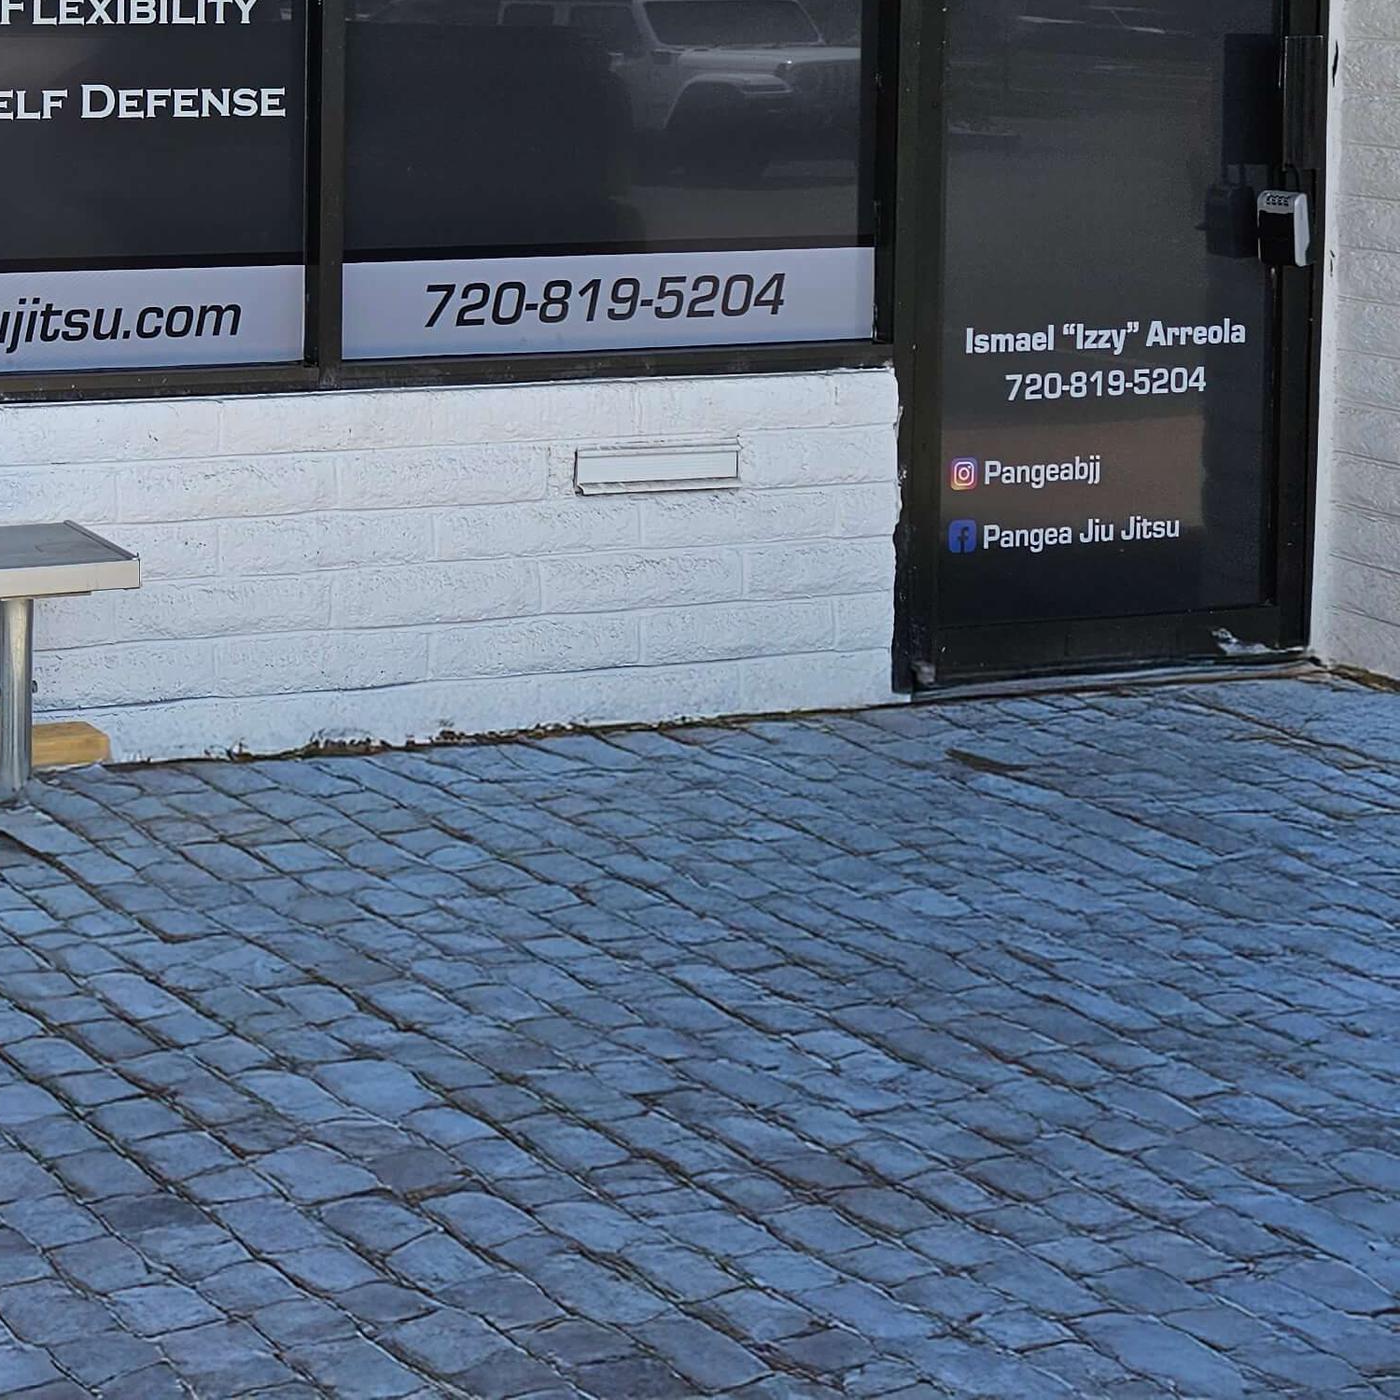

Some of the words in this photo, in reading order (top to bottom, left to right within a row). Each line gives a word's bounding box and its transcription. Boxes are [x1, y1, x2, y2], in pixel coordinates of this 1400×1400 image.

[80, 83, 287, 120] DEFENSE
[424, 272, 786, 328] 720-819-5204
[965, 324, 1054, 354] Ismael
[1146, 318, 1246, 348] Arreola
[1005, 366, 1207, 401] 720-819-5204
[984, 455, 1100, 489] Pangeabjj
[983, 524, 1072, 553] Pangea
[1079, 518, 1114, 543] Jiu
[1121, 516, 1180, 540] Jitsu
